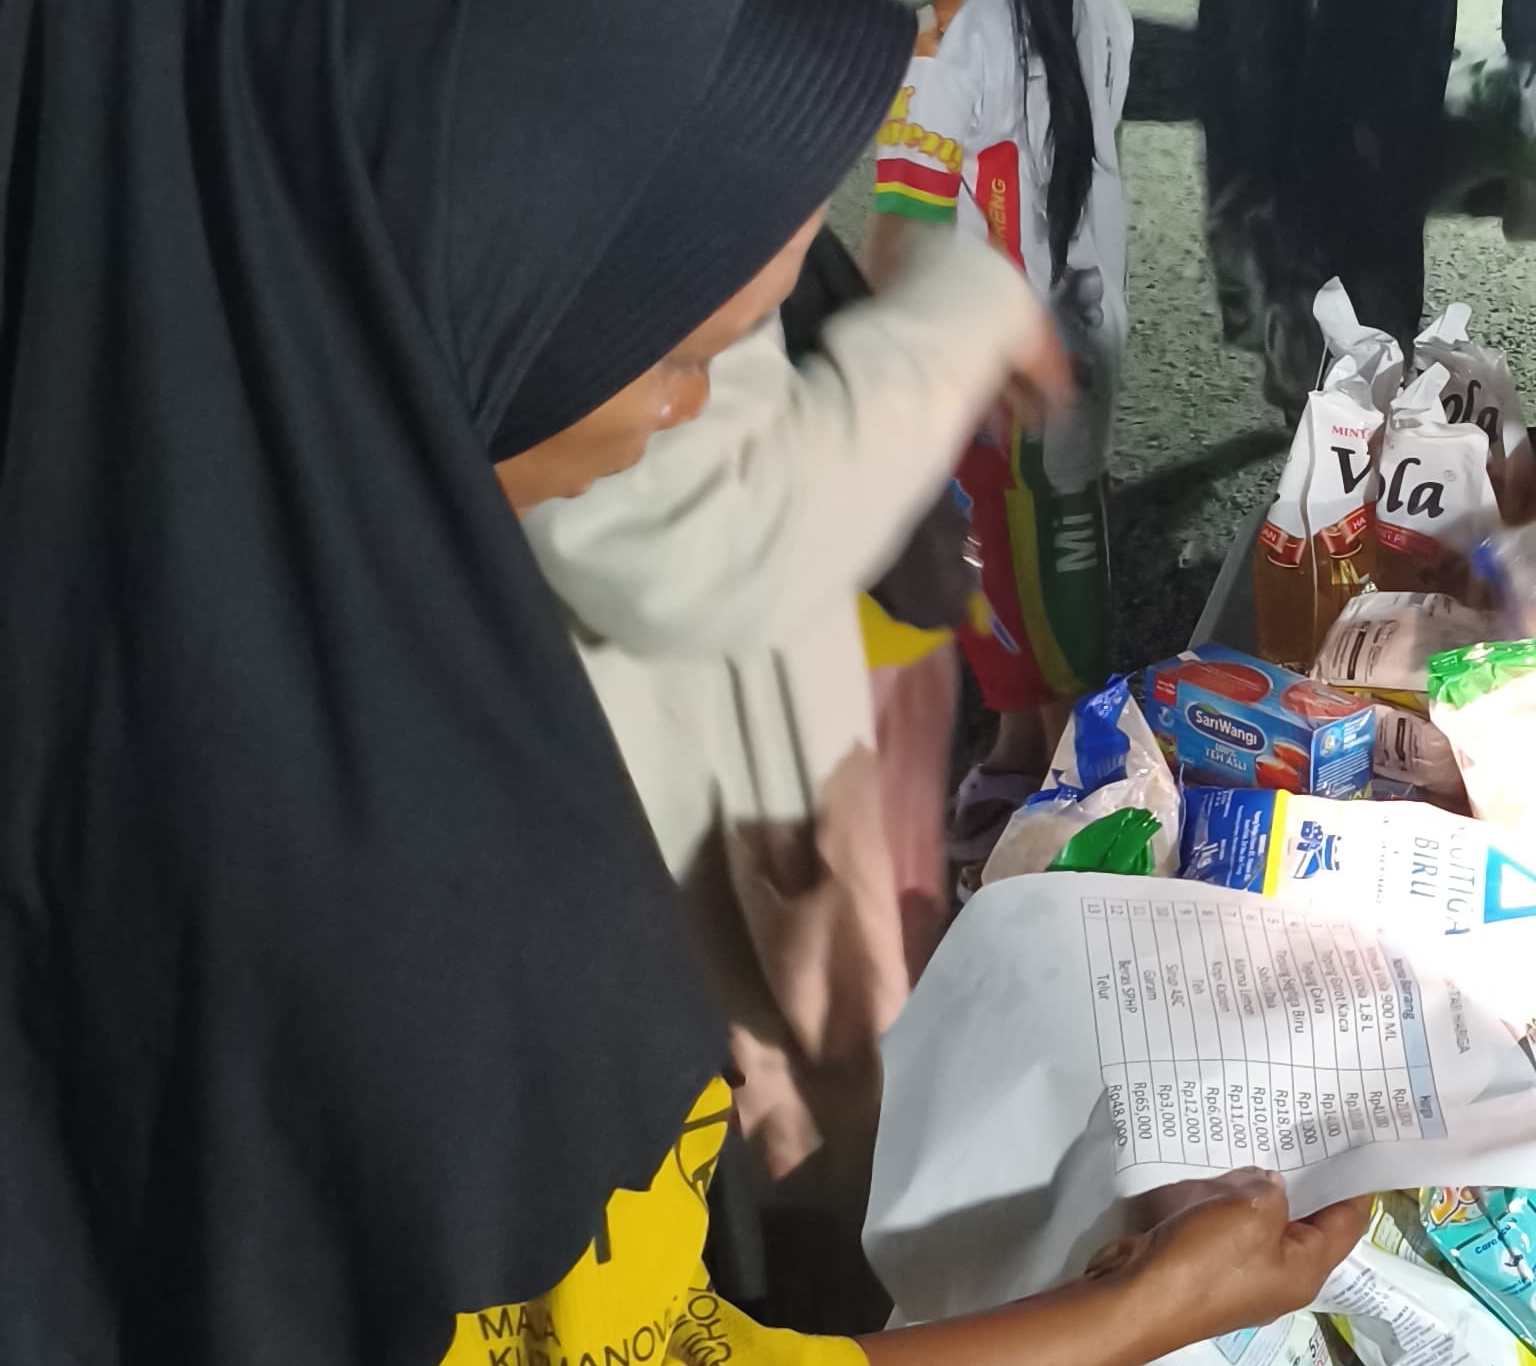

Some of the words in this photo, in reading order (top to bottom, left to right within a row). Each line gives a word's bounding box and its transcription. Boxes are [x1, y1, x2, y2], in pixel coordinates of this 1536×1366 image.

[1195, 709, 1258, 746] SariWangi
[1205, 748, 1226, 764] TEH
[1225, 755, 1247, 772] ASLI
[1410, 836, 1440, 898] BIRU
[1292, 1011, 1307, 1033] Biru
[1310, 987, 1325, 1014] Cakra
[1336, 1003, 1351, 1033] Kaca
[1358, 1003, 1372, 1022] 1,8
[1380, 994, 1395, 1019] 900
[1383, 1023, 1397, 1041] ML
[1096, 974, 1111, 1001] Telur
[1107, 1084, 1129, 1146] Rp48,000
[1132, 1082, 1152, 1140] Rp65,000
[1156, 1084, 1177, 1138] Rp3,000
[1181, 1080, 1201, 1144] Rp12,000
[1204, 1087, 1224, 1142] Rp6,000
[1227, 1084, 1248, 1149] Rp11,000
[1250, 1087, 1270, 1152] Rp10,000
[1273, 1089, 1294, 1151] Rp18,000
